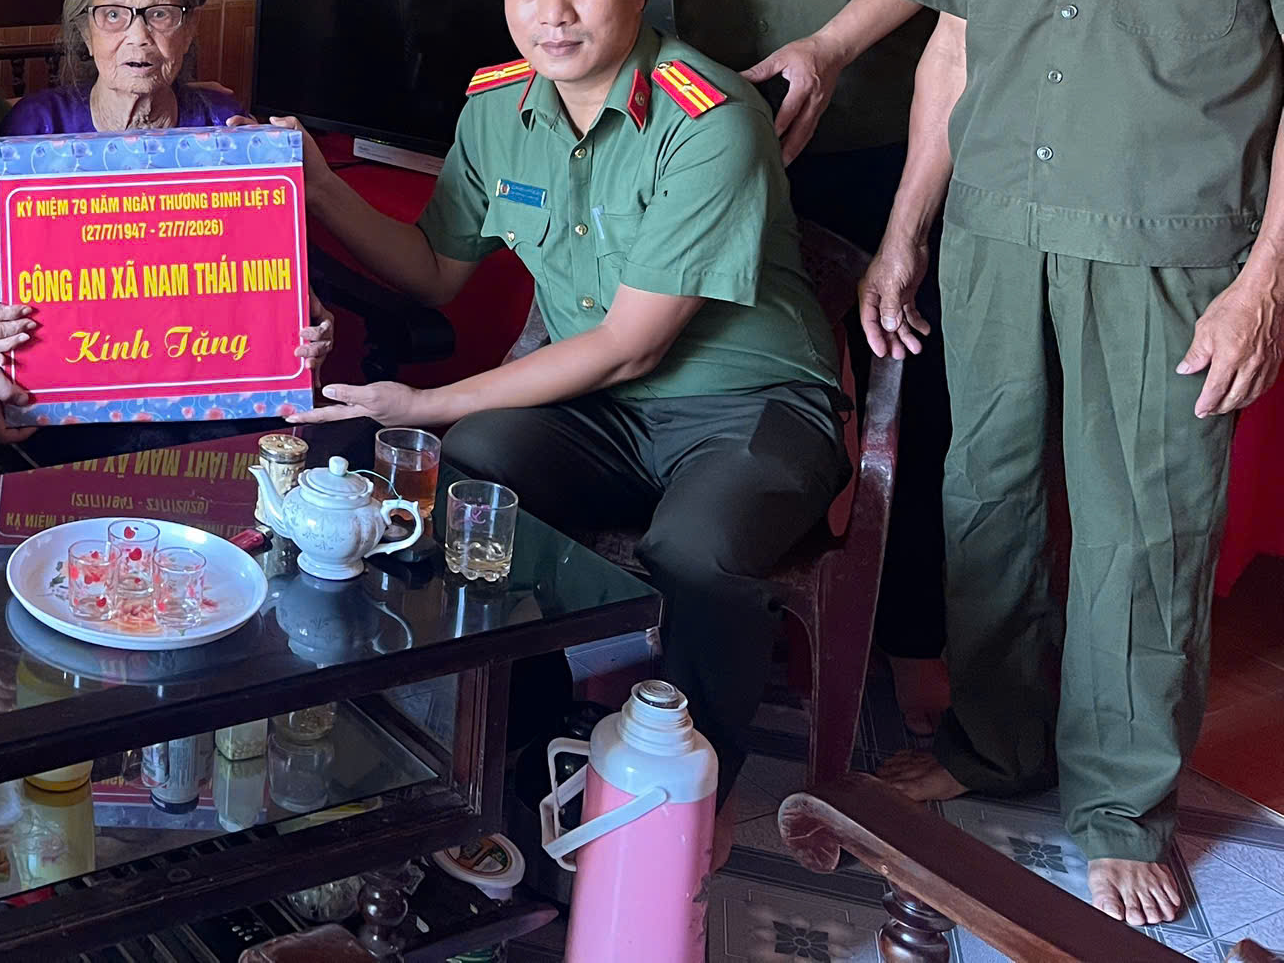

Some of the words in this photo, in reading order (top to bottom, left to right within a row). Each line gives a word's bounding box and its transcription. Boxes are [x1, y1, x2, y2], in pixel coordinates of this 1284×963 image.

[16, 196, 34, 218] KỶ
[37, 197, 69, 219] NIỆM
[73, 198, 88, 215] 79
[91, 193, 120, 214] NĂM
[123, 192, 156, 213] NGÀY
[159, 193, 209, 211] THƯƠNG
[212, 191, 242, 208] BINH
[244, 189, 271, 210] LIỆT
[273, 186, 286, 206] SĨ
[81, 220, 147, 242] (27/7/1947
[159, 218, 224, 237] 27/7/2026)
[19, 264, 73, 304] CÔNG
[79, 268, 106, 301] AN
[112, 260, 138, 299] XÃ
[143, 264, 189, 298] NAM
[194, 254, 237, 295] THÁI
[243, 258, 292, 292] NINH
[65, 327, 153, 363] Kính
[164, 325, 250, 363] Tặng
